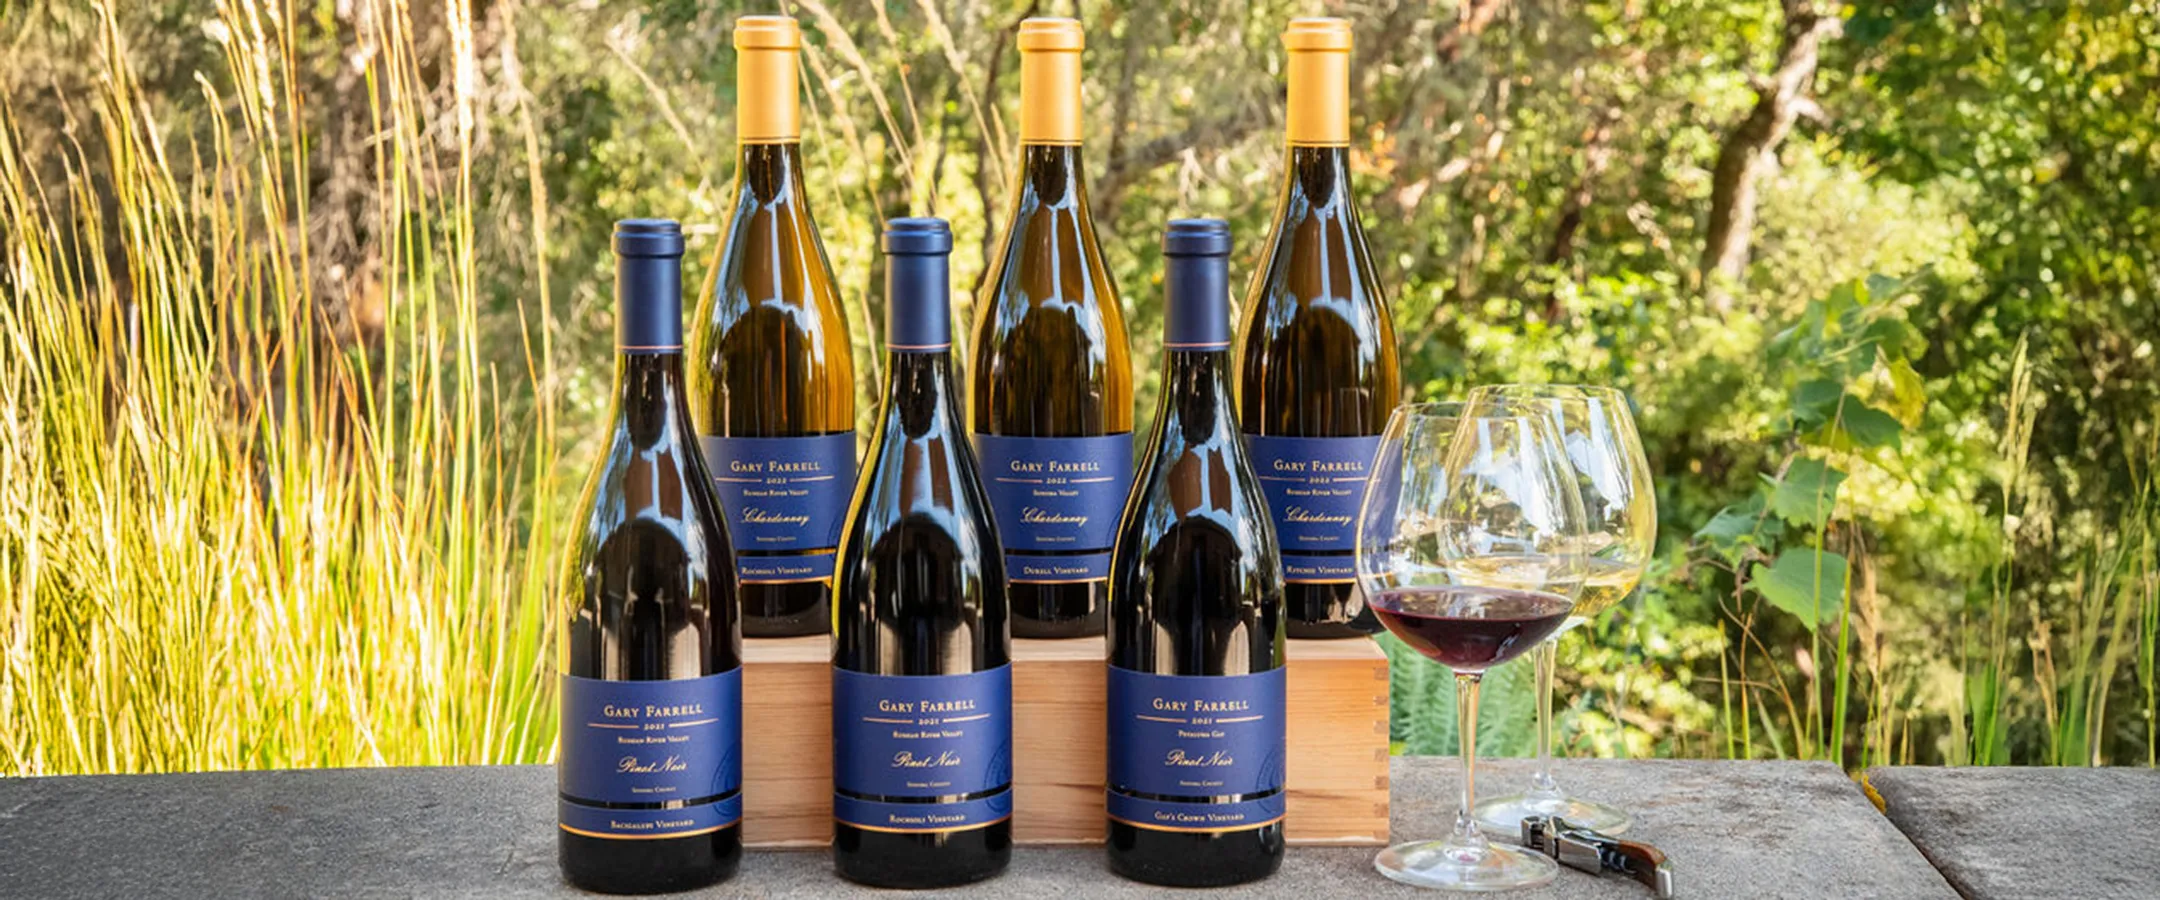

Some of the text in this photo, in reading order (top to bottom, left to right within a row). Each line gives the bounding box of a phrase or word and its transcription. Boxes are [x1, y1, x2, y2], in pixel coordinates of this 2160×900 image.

[731, 461, 820, 472] GARY FARRELL
[1011, 461, 1100, 472] GARY FARRELL
[1274, 459, 1364, 471] GARY FARRELL
[741, 507, 810, 526] Chardonnay
[1020, 507, 1088, 526] Chardonnay
[1284, 506, 1352, 526] Chardonnay
[604, 704, 703, 718] GARY FARRELL
[880, 699, 976, 712] GARY FARRELL
[1153, 698, 1249, 711] GARY FARRELL
[617, 754, 687, 772] Pinot Noir
[892, 750, 961, 767] Pinot Noir
[1165, 749, 1233, 766] Pinot Noir
